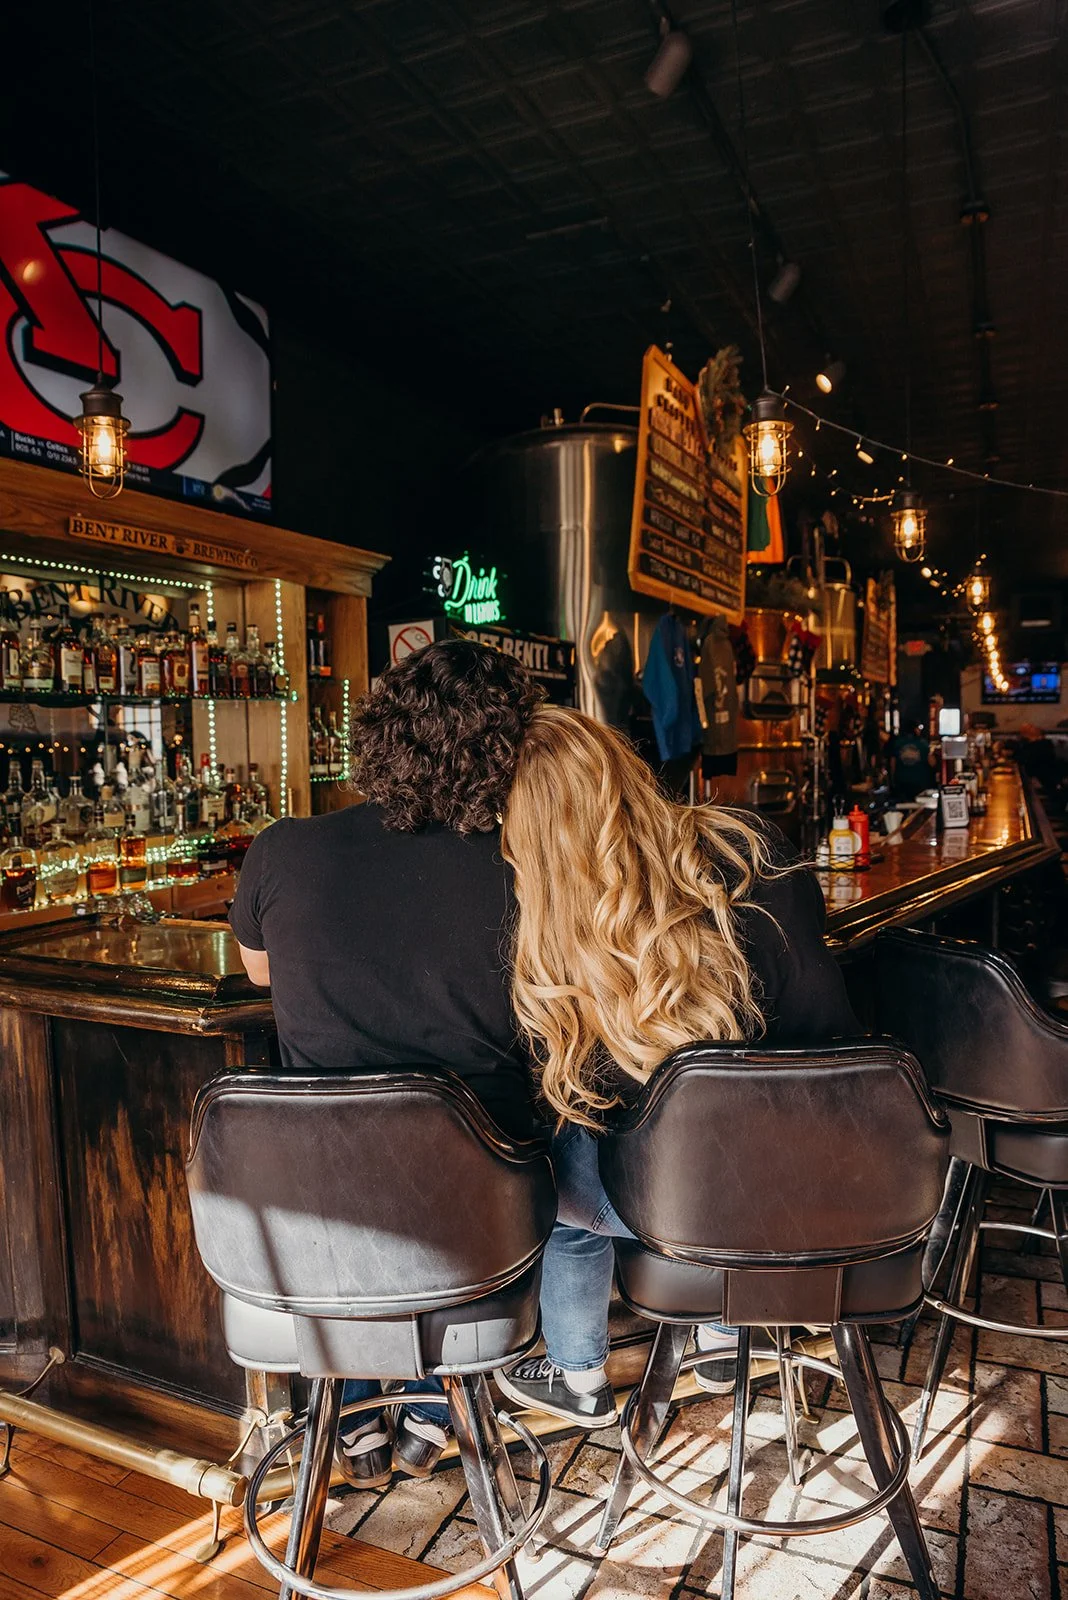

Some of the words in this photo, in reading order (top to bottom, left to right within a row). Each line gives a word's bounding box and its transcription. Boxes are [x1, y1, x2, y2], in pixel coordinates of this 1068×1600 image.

[72, 519, 120, 540] BENT
[122, 528, 168, 549] RIVER
[193, 543, 245, 564] BREWING
[444, 559, 499, 610] Drink
